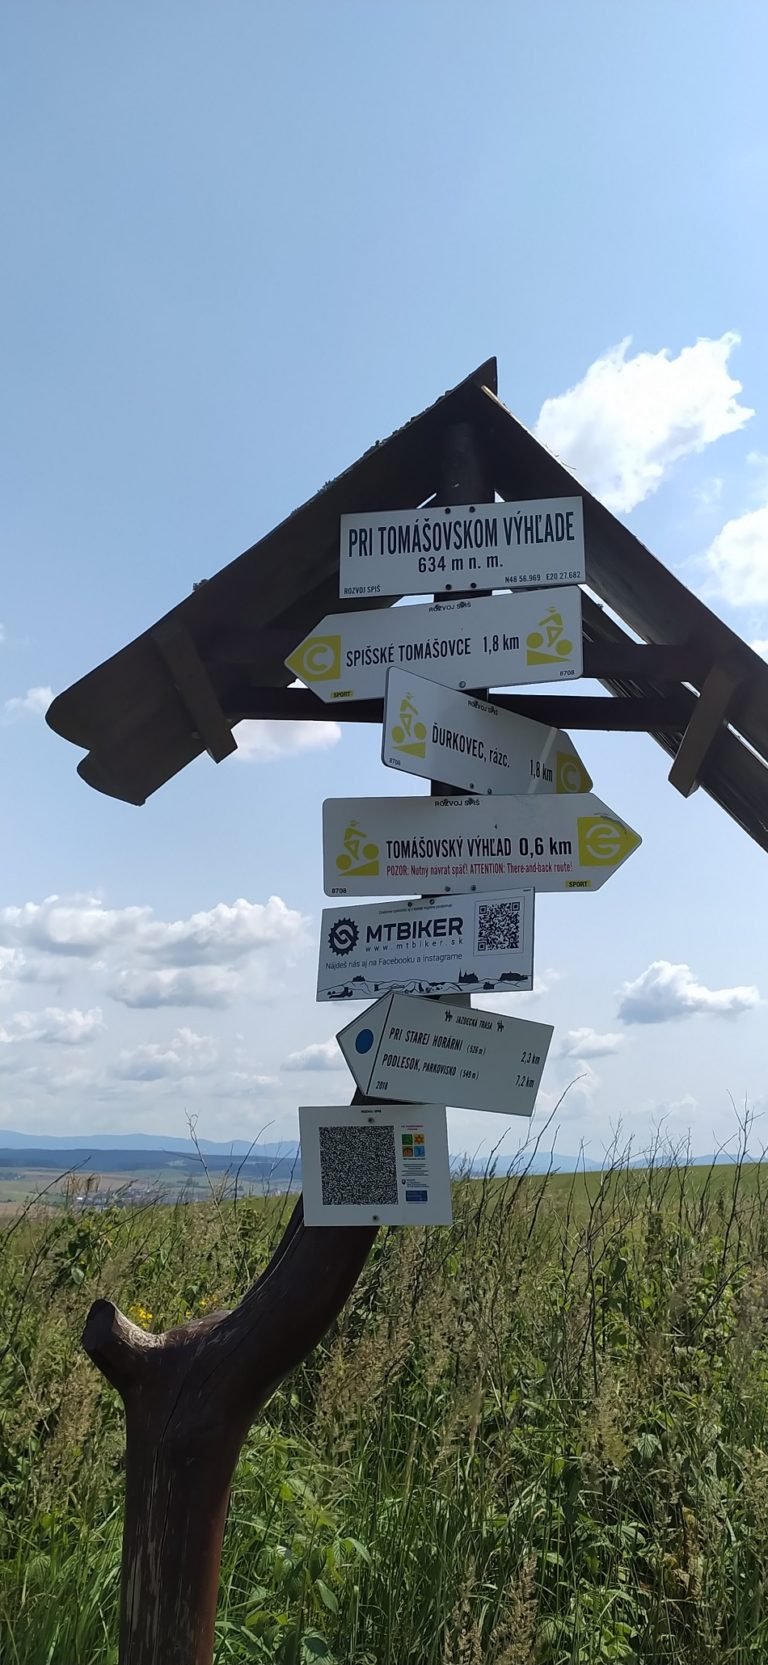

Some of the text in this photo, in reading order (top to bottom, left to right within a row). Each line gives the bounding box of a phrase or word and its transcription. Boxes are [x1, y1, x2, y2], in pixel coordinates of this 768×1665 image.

[349, 511, 575, 557] PRI TOMÁŠOVSKOM VÝHĽADE
[418, 556, 504, 573] 634 m n. m.
[505, 574, 518, 584] N48
[546, 572, 558, 581] E20
[559, 570, 581, 580] 27.682
[343, 584, 381, 595] ROZVOJ SPIŠ
[346, 634, 520, 667] SPIŠSKÉ TOMÁŠOVCE 1,8 km
[559, 669, 576, 677] 8708
[431, 722, 553, 782] ĎURKOVEC, rázc. 1,8 km
[386, 834, 572, 859] TOMÁŠOVSKÝ VÝHĽAD 0,6 km
[386, 865, 409, 876] POZOR:
[470, 863, 505, 875] ATTENTION:
[554, 861, 573, 872] route!
[331, 887, 347, 895] 8708
[568, 880, 589, 889] SPORT
[366, 917, 464, 943] MTBIKER
[378, 955, 415, 966] Facebooku
[478, 1020, 493, 1030] TRASA
[388, 1027, 403, 1040] PRI
[404, 1030, 430, 1046] STAREJ
[432, 1035, 464, 1051] HORÁRNI
[520, 1051, 532, 1065] 2,3
[532, 1052, 541, 1065] km
[381, 1053, 421, 1072] PODLESOK,
[422, 1062, 457, 1076] PARKOVISKO
[515, 1074, 526, 1088] 7,2
[526, 1076, 535, 1089] km
